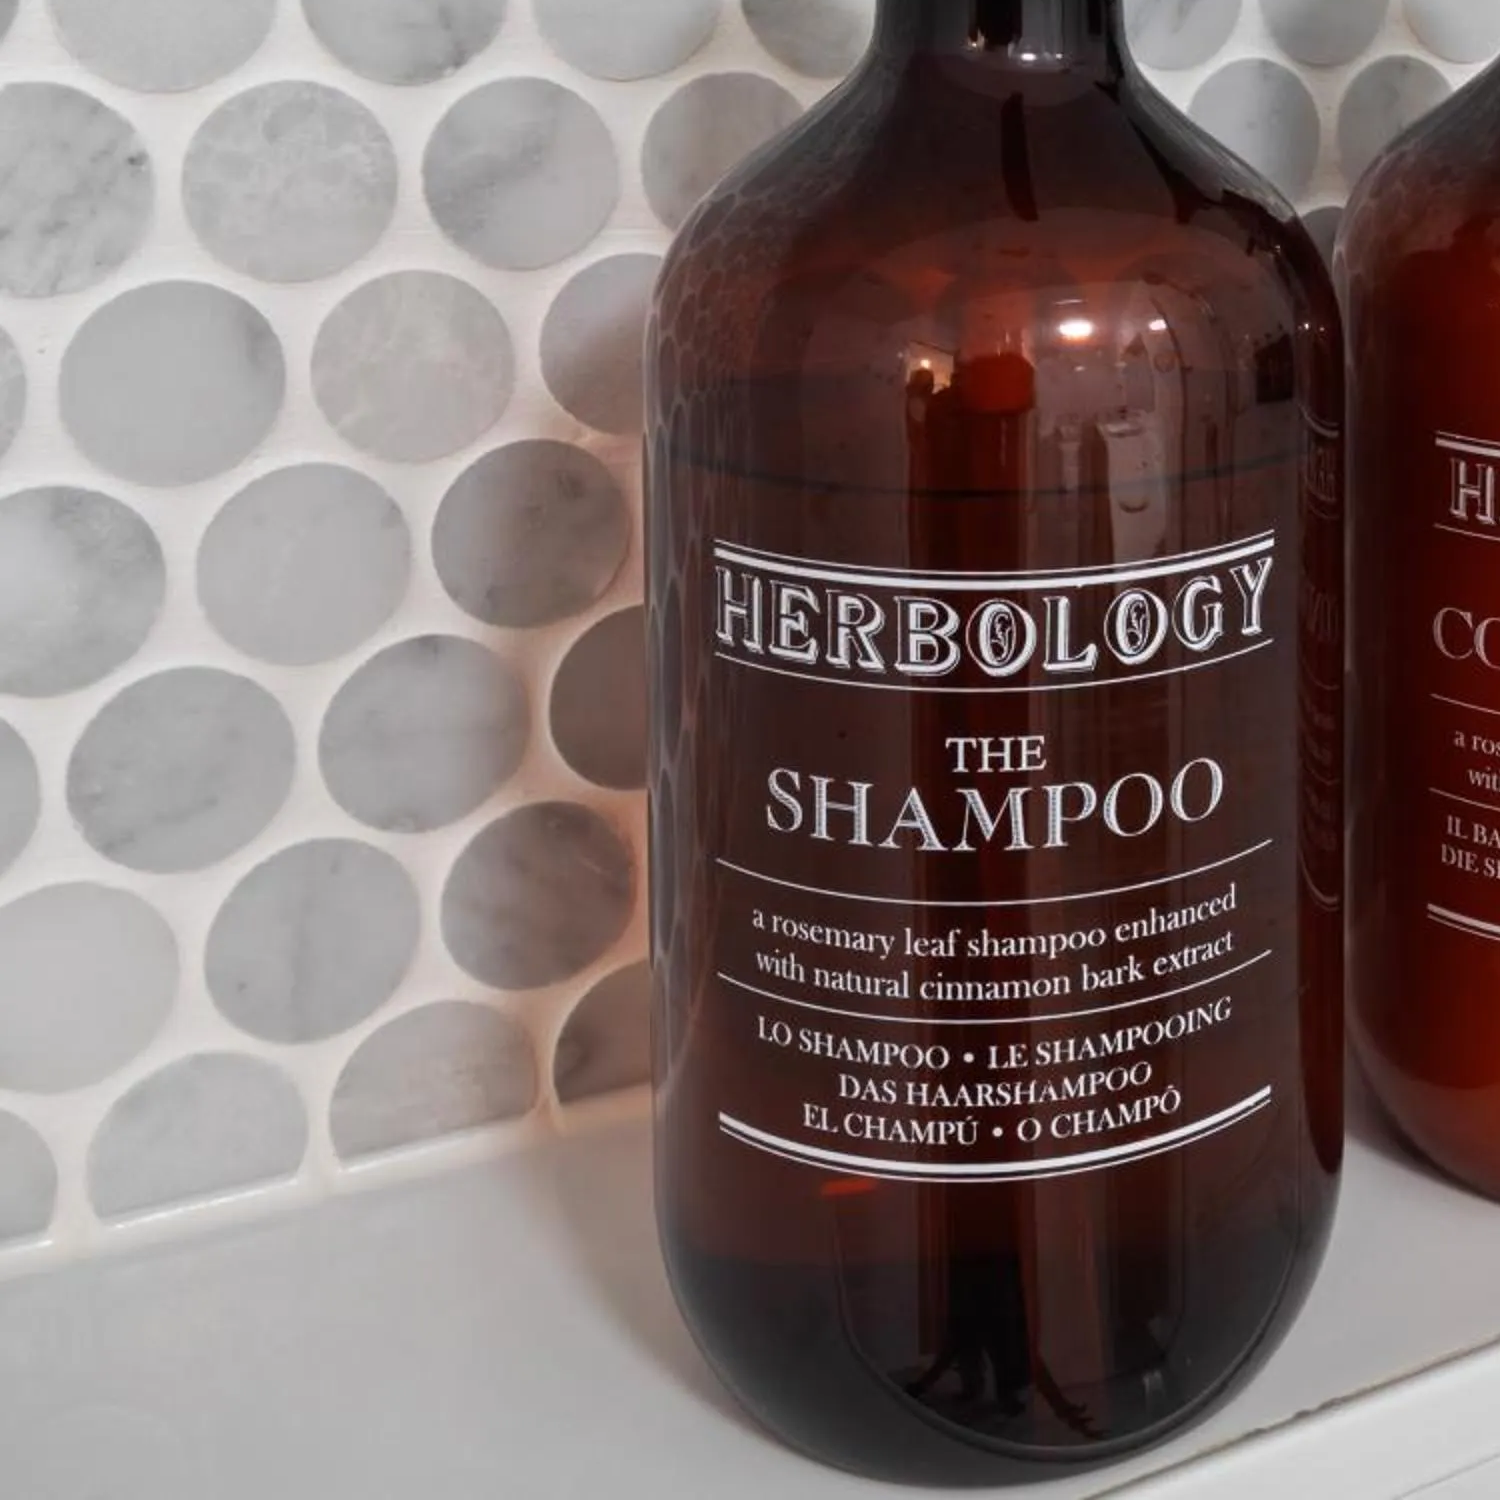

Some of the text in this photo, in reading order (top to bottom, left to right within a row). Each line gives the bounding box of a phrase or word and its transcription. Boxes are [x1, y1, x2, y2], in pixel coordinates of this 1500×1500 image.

[715, 557, 1273, 677] HERBOLOGY
[945, 735, 1046, 773] THE
[1454, 730, 1465, 747] a
[766, 757, 1223, 851] SHAMPOO
[1446, 815, 1468, 838] IL
[1441, 844, 1480, 871] DIE
[753, 883, 1235, 958] a rosemary leaf shampoo enhanced
[756, 931, 1233, 1000] with natural cinnamon bark extract
[758, 996, 1232, 1069] LO SHAMPOO LE SHAMPOOING
[802, 1084, 1181, 1145] EL CHAMPÚ O CHAMPÔ
[839, 1061, 1152, 1107] DAS HAARSHAMPOO
